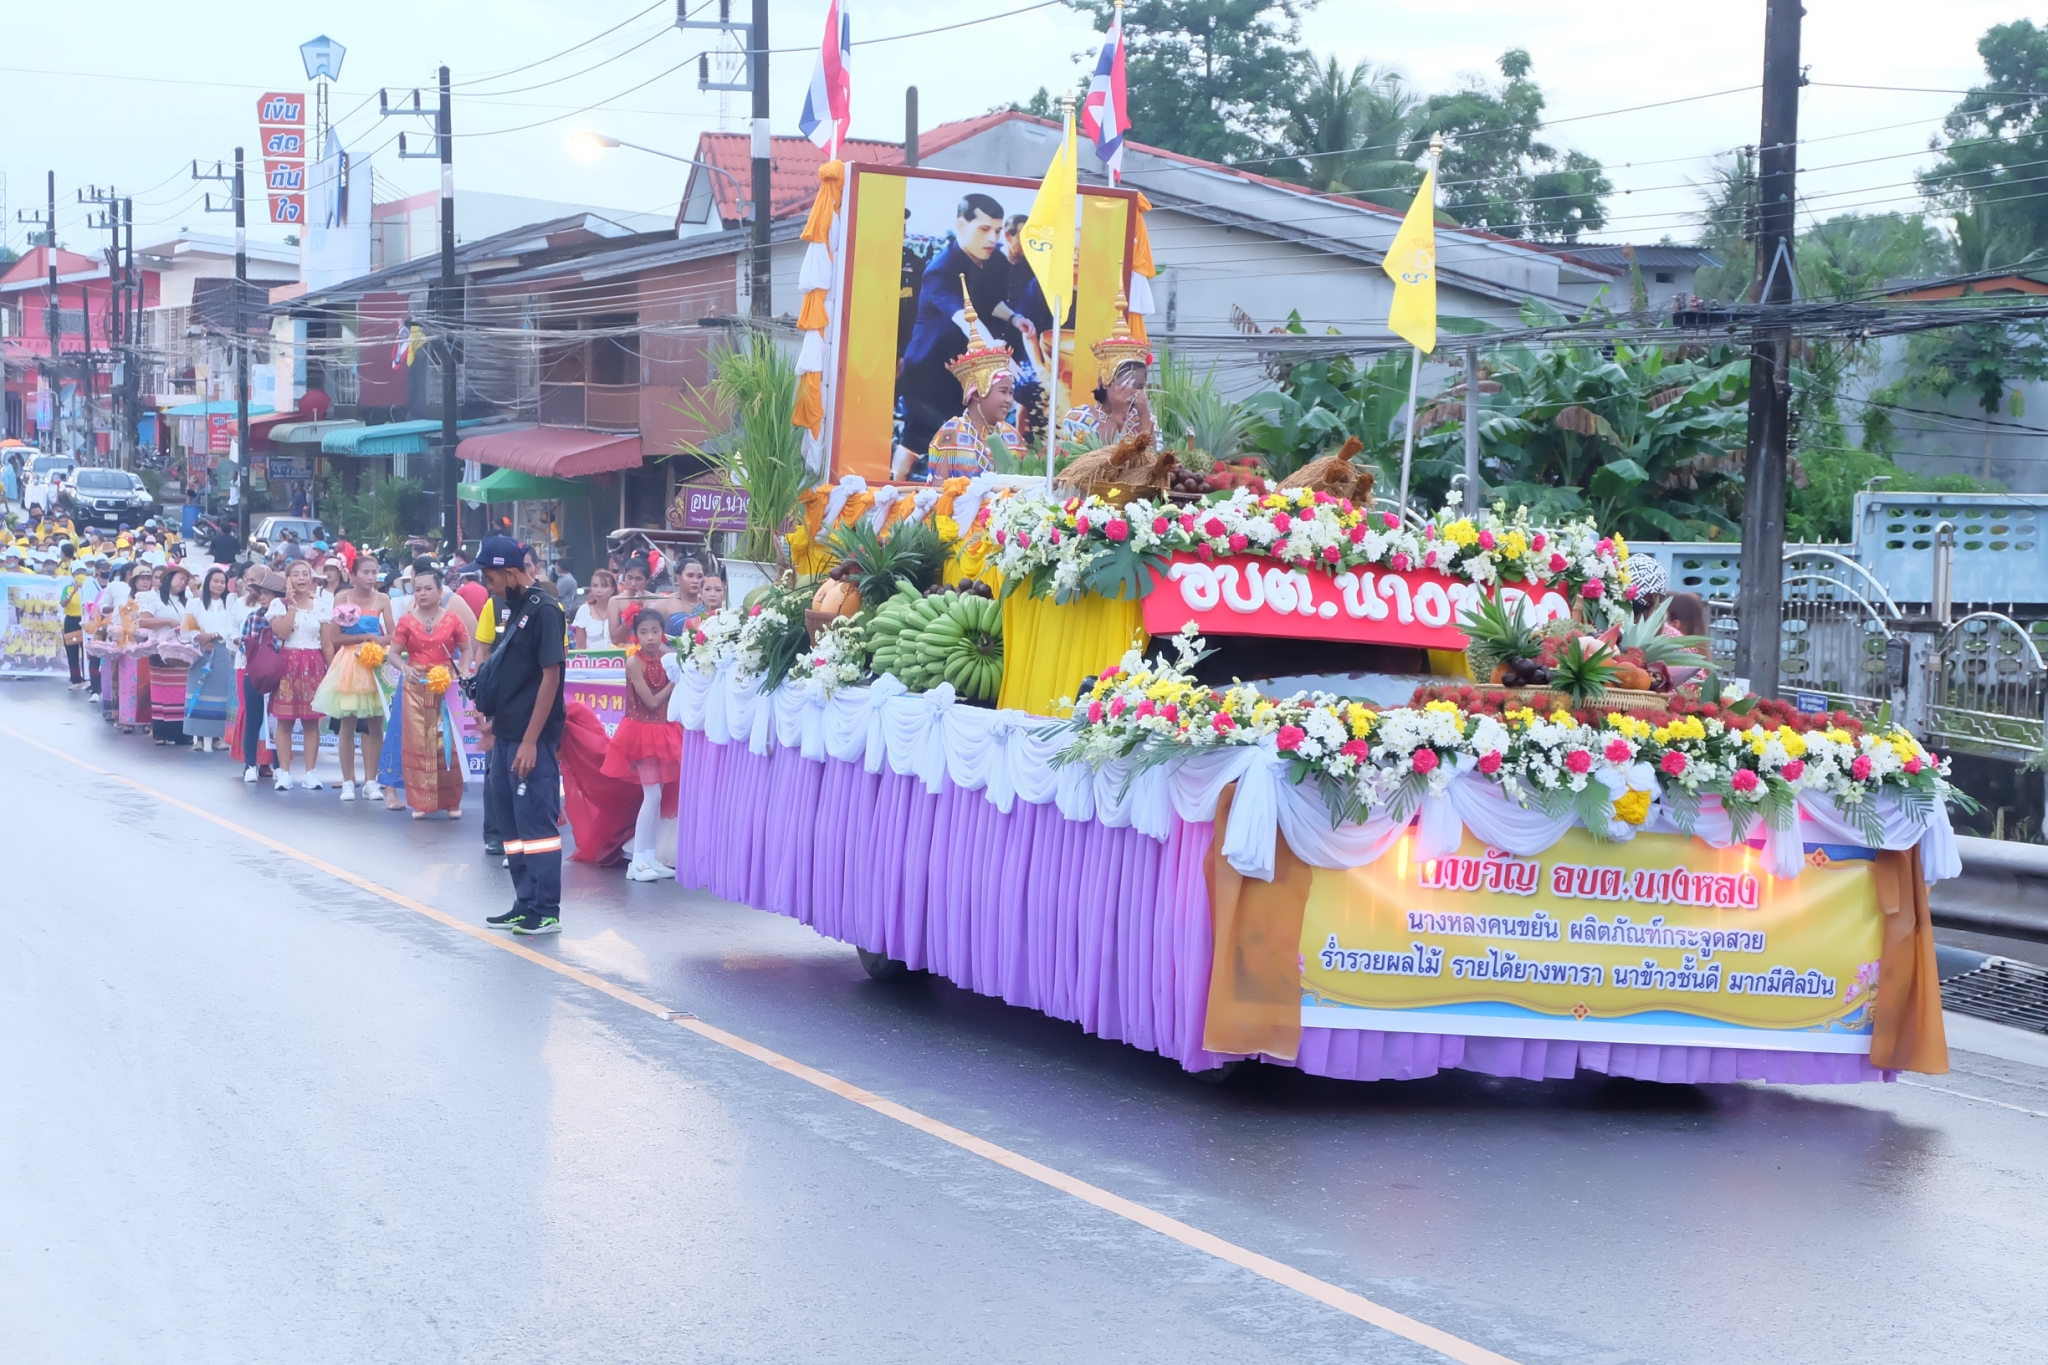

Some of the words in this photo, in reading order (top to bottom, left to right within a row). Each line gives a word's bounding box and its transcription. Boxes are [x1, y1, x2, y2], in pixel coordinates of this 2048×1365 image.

[263, 98, 299, 120] เงิน
[268, 134, 300, 152] สด
[271, 164, 301, 187] ทัน
[277, 198, 299, 220] ใจ
[1553, 866, 1756, 906] อบต.นางหลง
[1408, 911, 1559, 939] นางหลงคนขยัน
[1570, 916, 1764, 958] ผลิตภัณฑ์กระจูดสวย
[1320, 936, 1441, 974] ร่ำรวยผลไม้
[1451, 949, 1603, 984] รายได้ยางพารา
[1613, 956, 1720, 990] นาข้าวชั้นดี
[1729, 968, 1835, 996] มากมีศิลปิน
